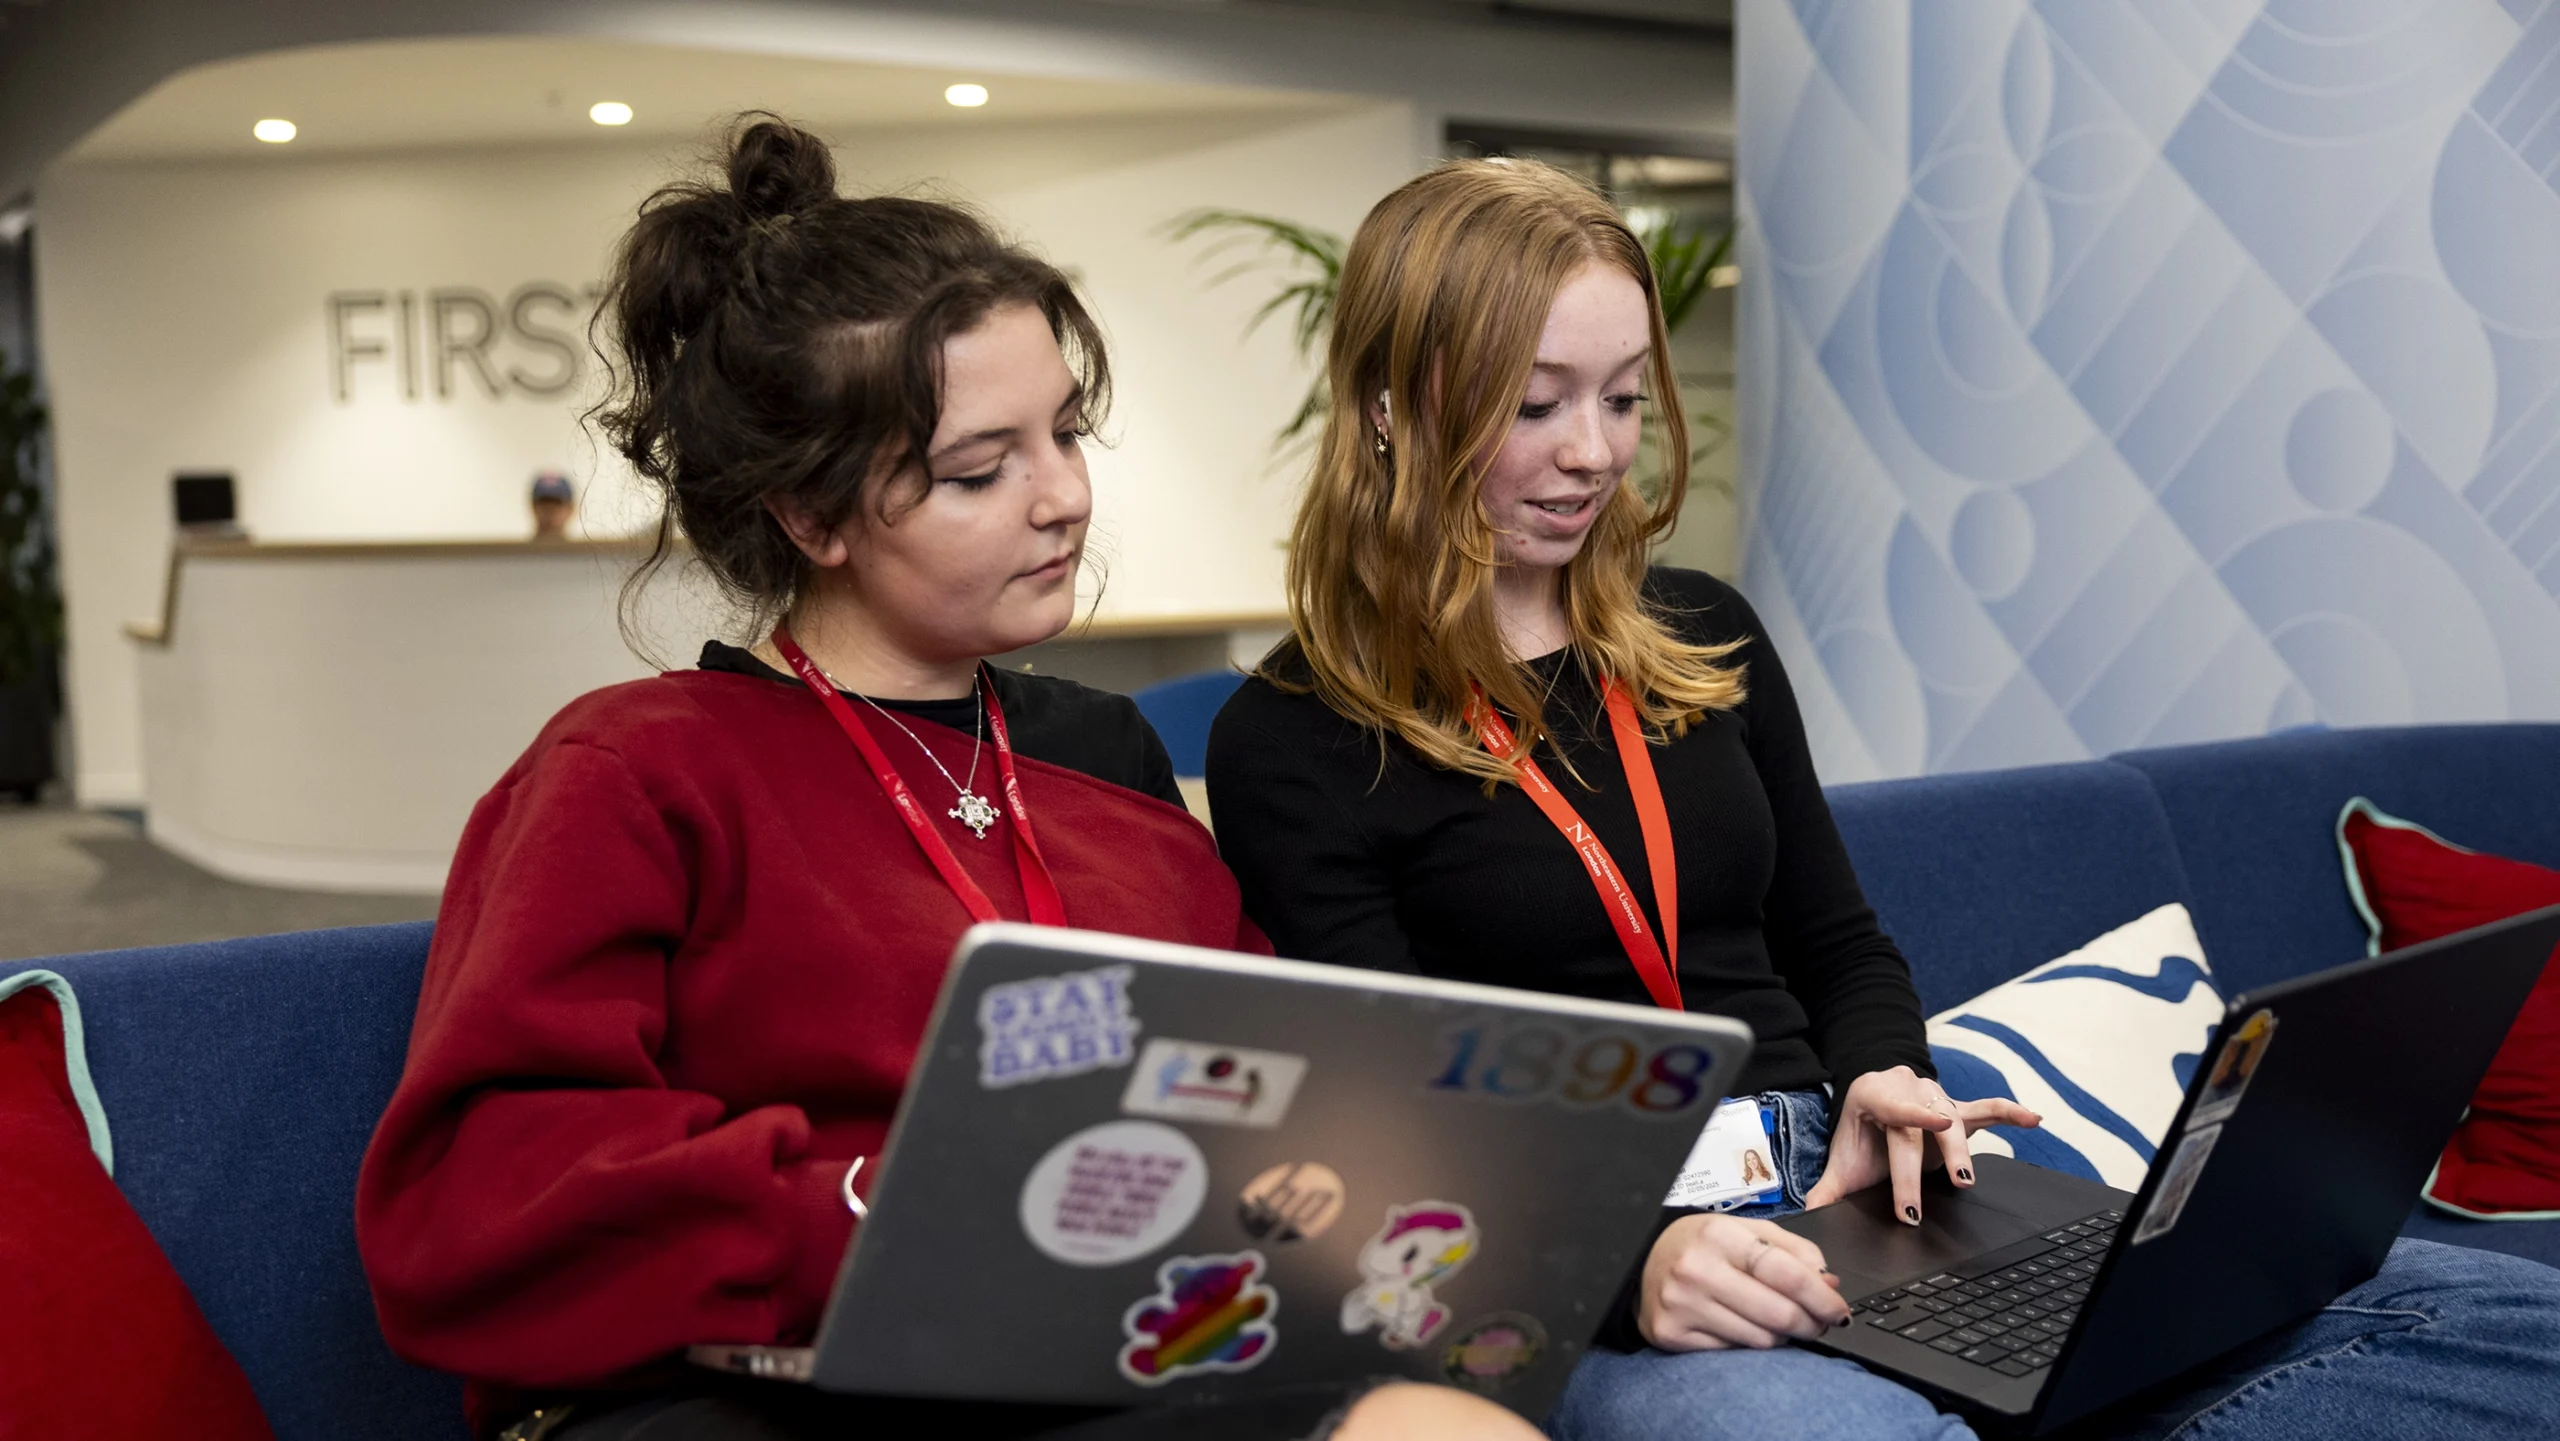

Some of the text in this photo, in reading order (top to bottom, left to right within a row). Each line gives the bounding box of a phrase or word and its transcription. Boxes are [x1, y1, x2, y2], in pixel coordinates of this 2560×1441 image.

[325, 284, 606, 403] FIRS
[1565, 821, 1593, 843] N
[1581, 846, 1602, 877] London
[1589, 842, 1643, 934] Northeastern University
[1428, 1024, 1714, 1112] 1898
